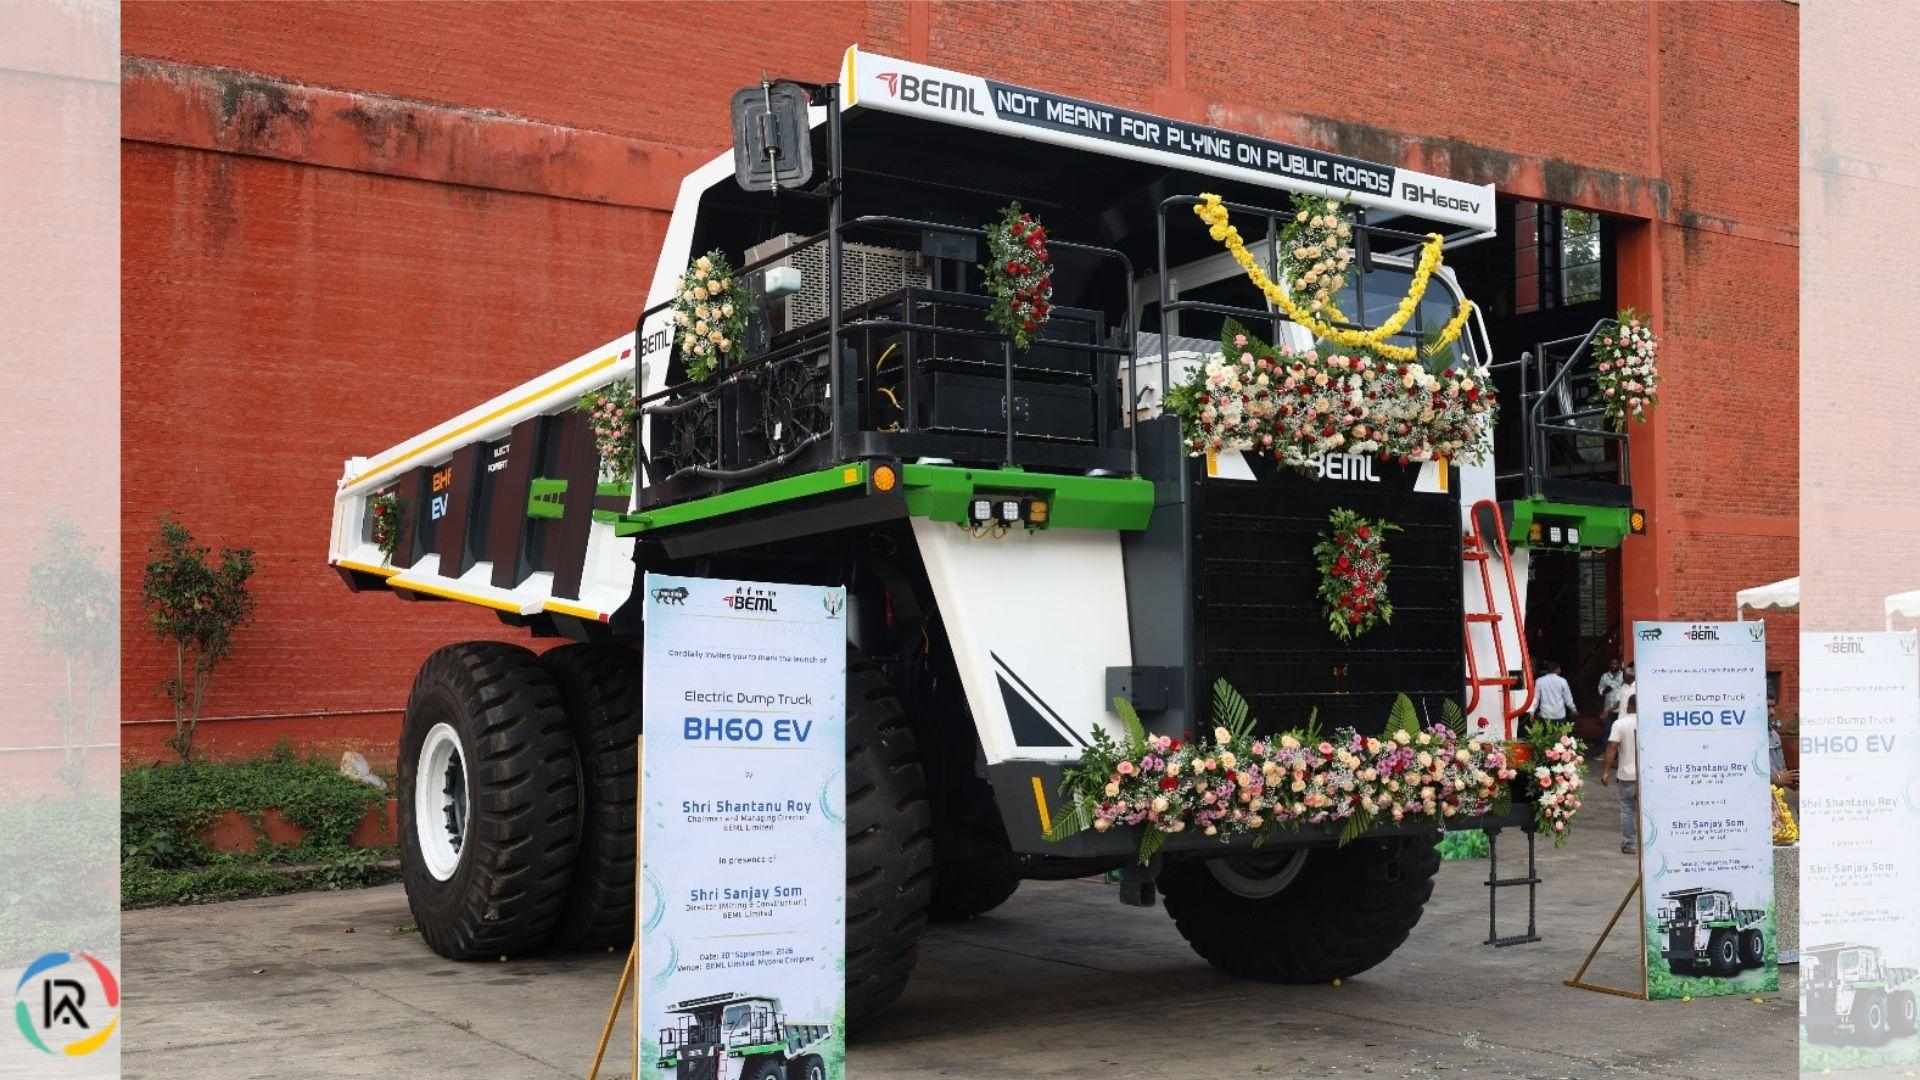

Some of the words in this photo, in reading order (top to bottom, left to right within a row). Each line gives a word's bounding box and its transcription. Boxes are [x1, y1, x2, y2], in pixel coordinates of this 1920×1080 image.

[900, 74, 984, 116] BEML
[997, 90, 1039, 115] NOT
[1046, 99, 1114, 133] MEANT
[1120, 116, 1160, 144] FOR
[1166, 126, 1231, 159] PLYING
[1237, 143, 1261, 167] ON
[1267, 149, 1329, 180] PUBLIC
[1333, 163, 1390, 193] ROADS
[1401, 182, 1481, 214] BH60EV
[641, 329, 671, 358] BEML
[431, 493, 449, 520] EV
[735, 596, 777, 612] BEML
[1691, 630, 1720, 640] BEML
[684, 690, 733, 703] Electric
[737, 692, 775, 706] Dump
[778, 693, 812, 705] Truck
[1662, 693, 1694, 702] Electric
[1695, 693, 1721, 703] Dump
[1723, 693, 1746, 701] Truck
[1663, 711, 1713, 727] BH60
[1720, 710, 1746, 726] EV
[683, 716, 763, 741] BH60
[773, 719, 813, 742] EV
[1800, 735, 1858, 754] BH60
[1866, 734, 1896, 753] EV
[1664, 764, 1683, 773] Shri
[1685, 763, 1728, 773] Shantanu
[1730, 763, 1748, 773] Roy
[682, 801, 711, 813] Shri
[716, 800, 781, 813] Shantanu
[787, 800, 812, 814] Roy
[1672, 820, 1690, 829] Shri
[1693, 819, 1722, 829] Sanjay
[1725, 819, 1745, 827] Som
[690, 888, 718, 901] Shri
[724, 886, 770, 902] Sanjay
[773, 885, 802, 897] Som
